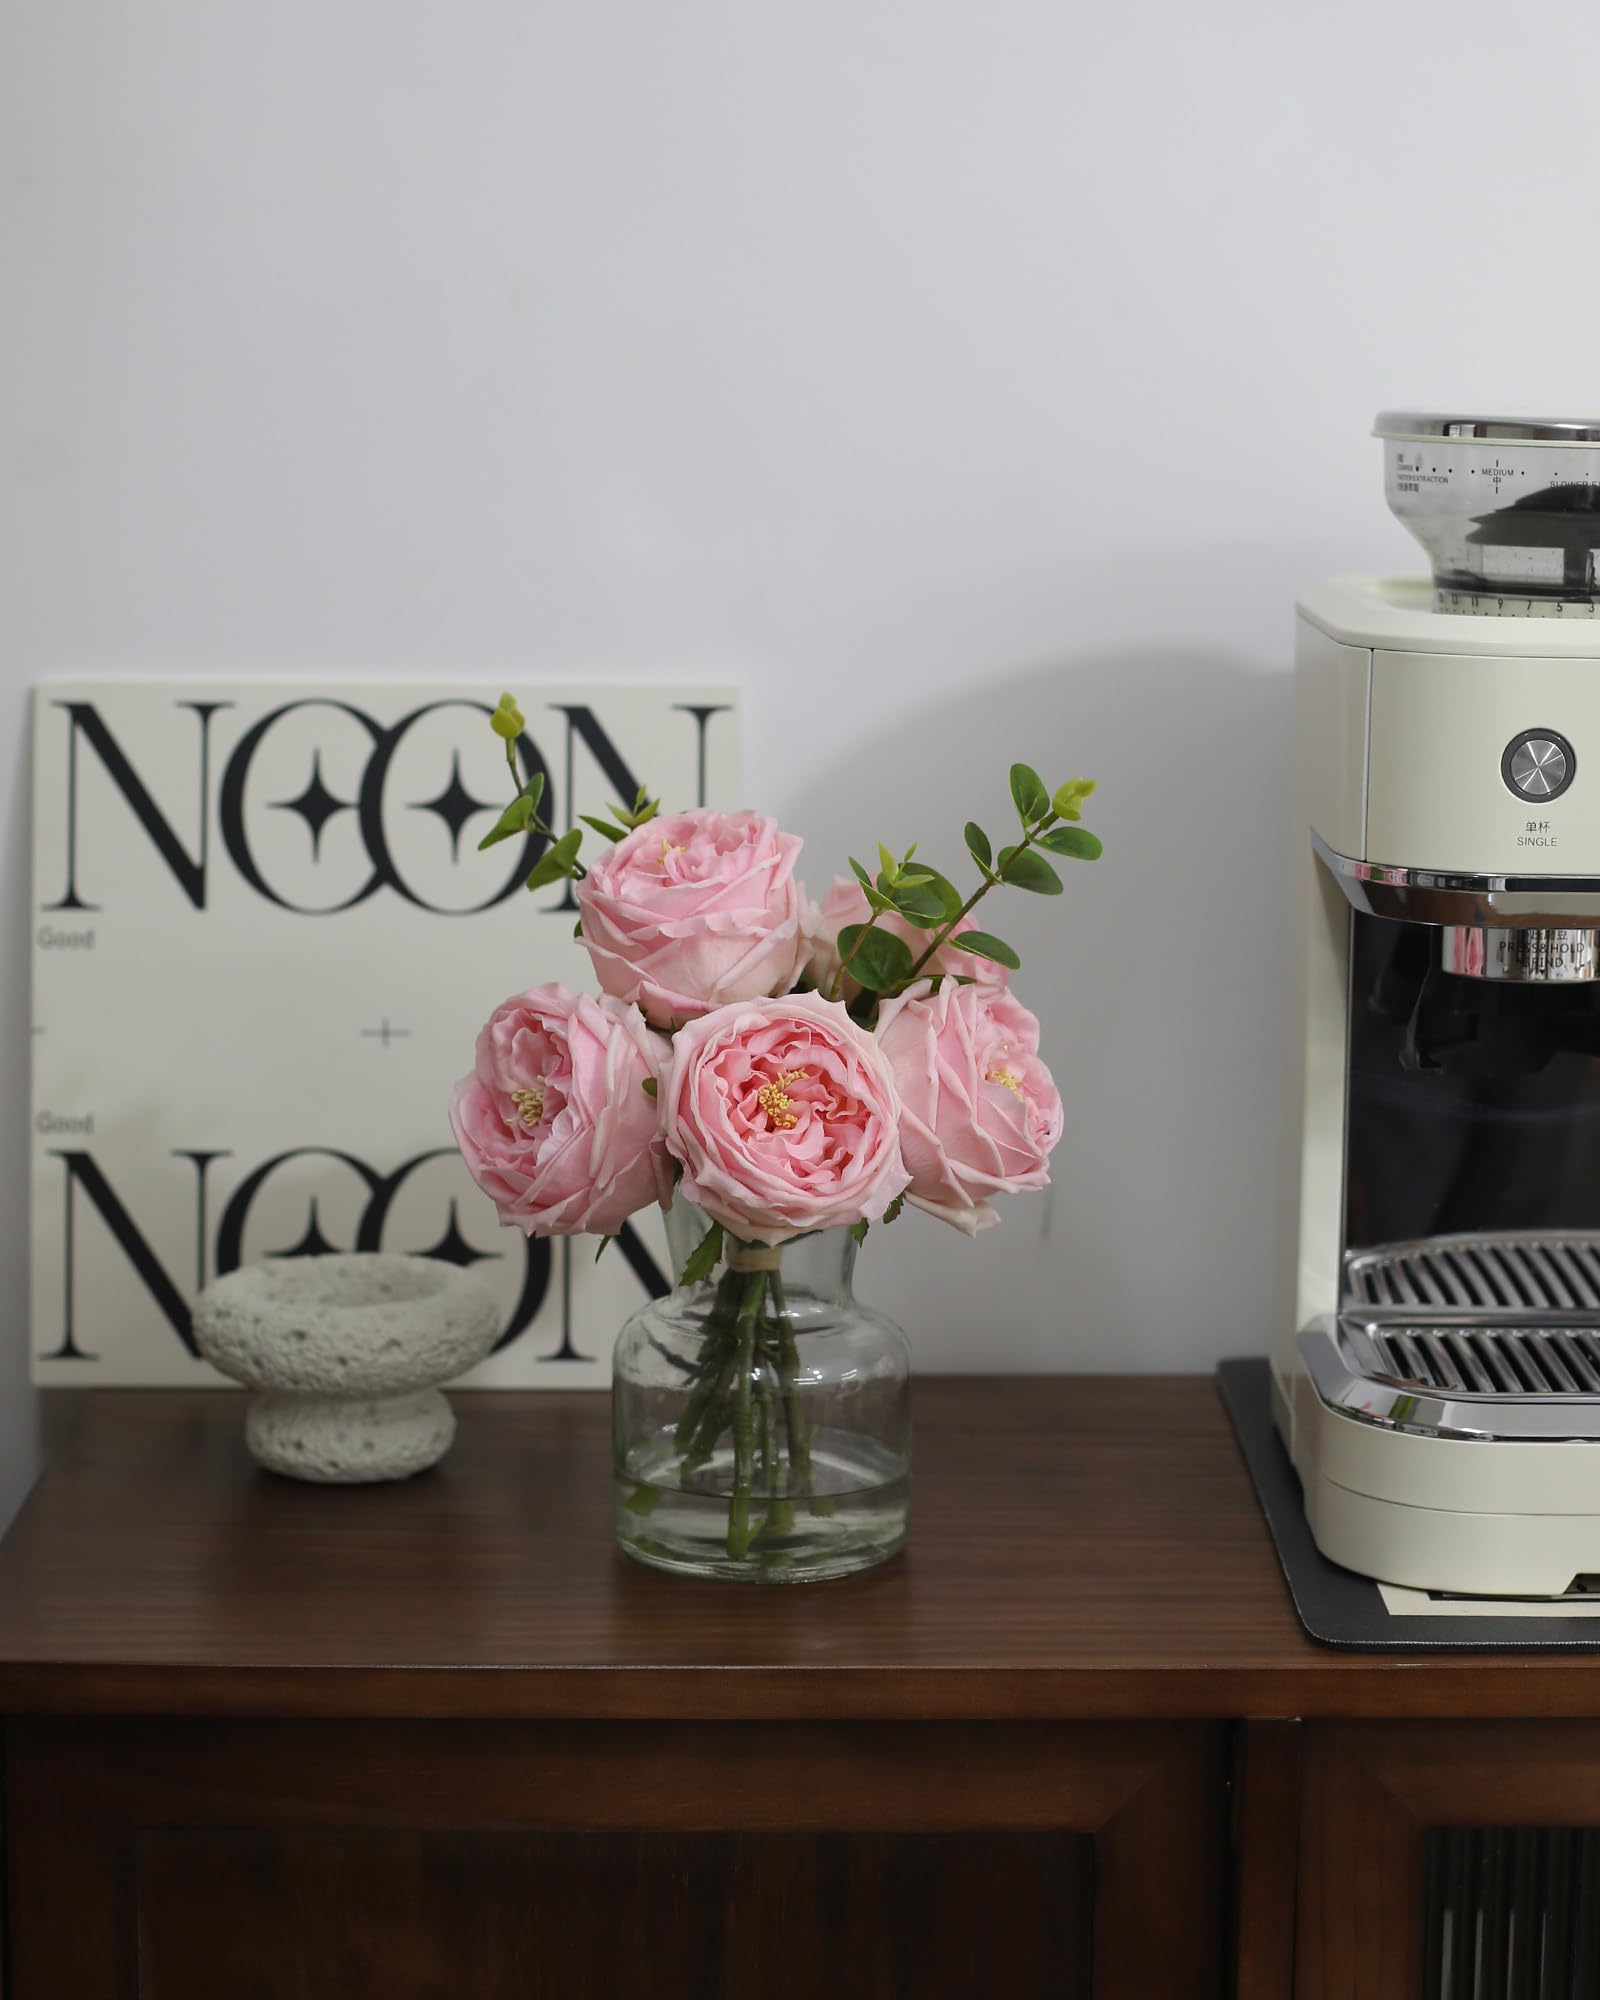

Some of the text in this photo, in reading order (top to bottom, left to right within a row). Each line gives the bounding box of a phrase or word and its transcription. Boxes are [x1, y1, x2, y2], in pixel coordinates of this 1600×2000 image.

[1482, 468, 1514, 476] MEDIUM
[1497, 598, 1503, 609] 9
[1525, 820, 1551, 834] 单杯
[1517, 836, 1558, 847] SINGLE
